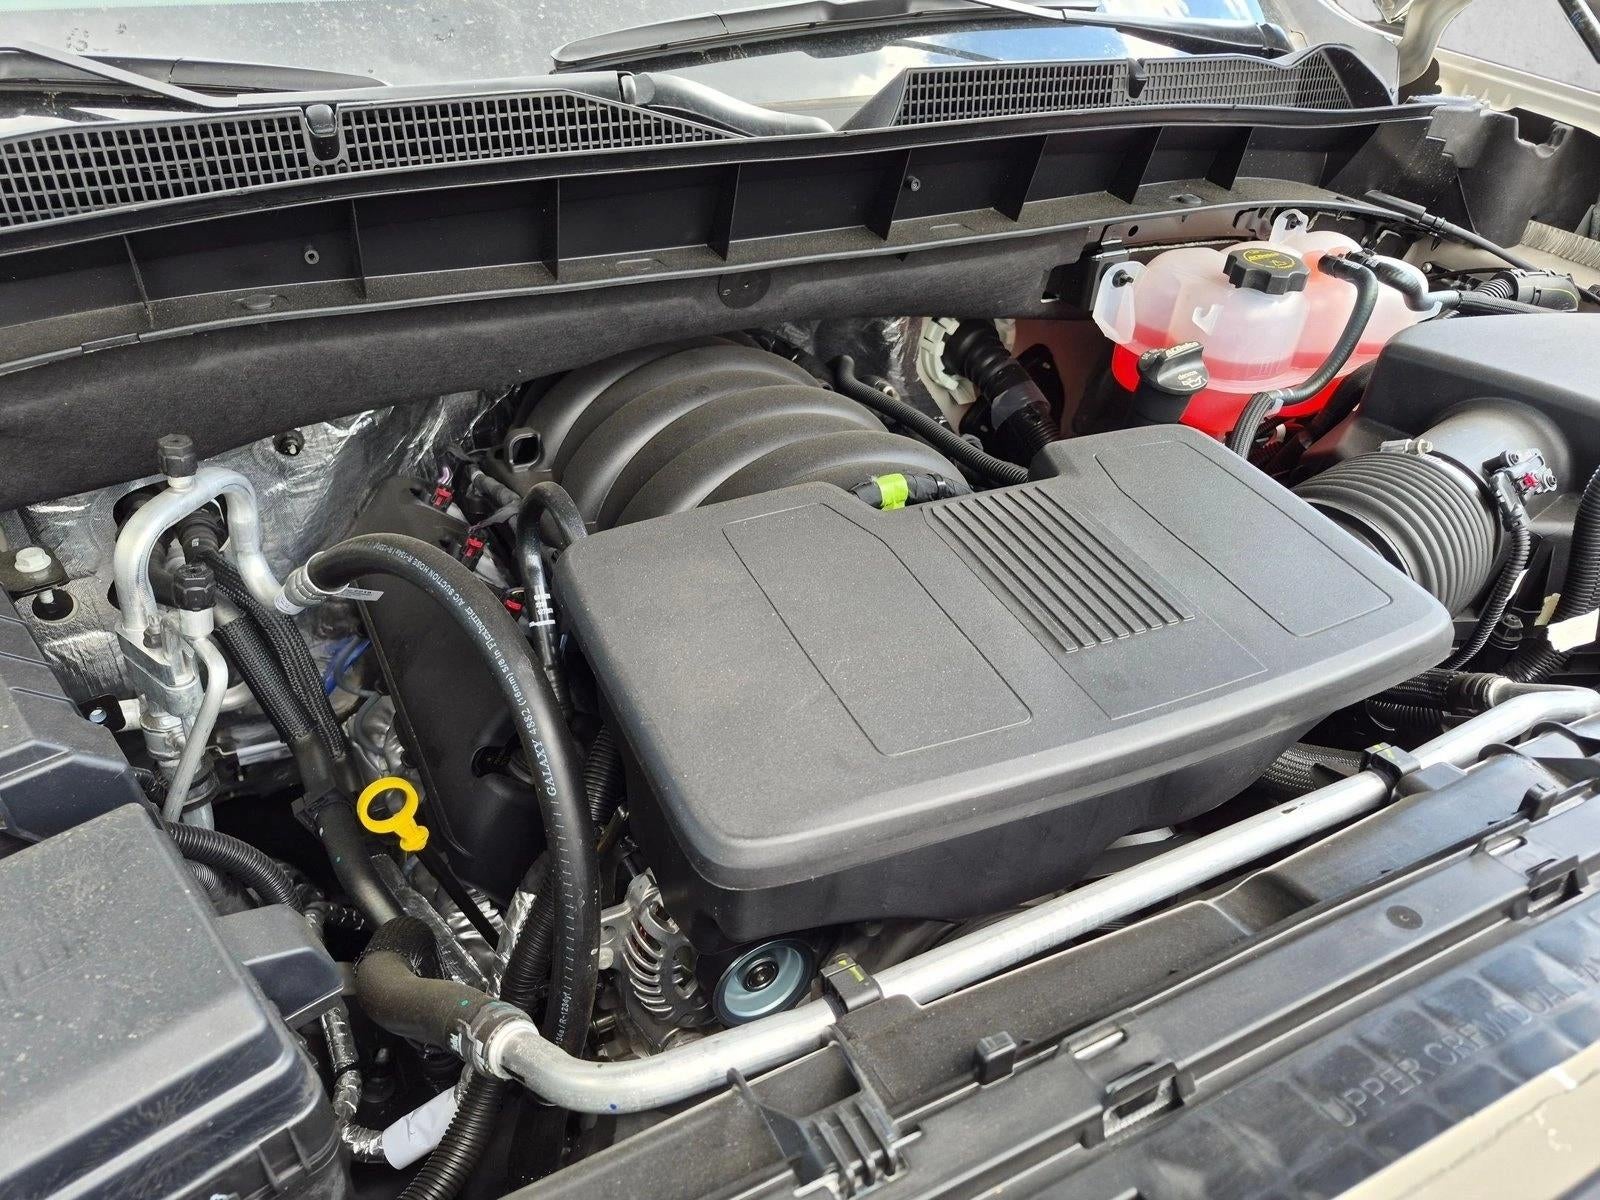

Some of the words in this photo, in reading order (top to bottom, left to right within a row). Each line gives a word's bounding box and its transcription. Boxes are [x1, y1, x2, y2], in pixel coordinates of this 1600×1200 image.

[411, 558, 430, 573] HOSE
[428, 569, 454, 596] SUCTION
[452, 593, 465, 606] A/C
[464, 606, 497, 651] Flexbarrier
[505, 671, 527, 706] (16mm)
[531, 739, 557, 797] GALAXY
[1323, 1057, 1436, 1127] UPPER
